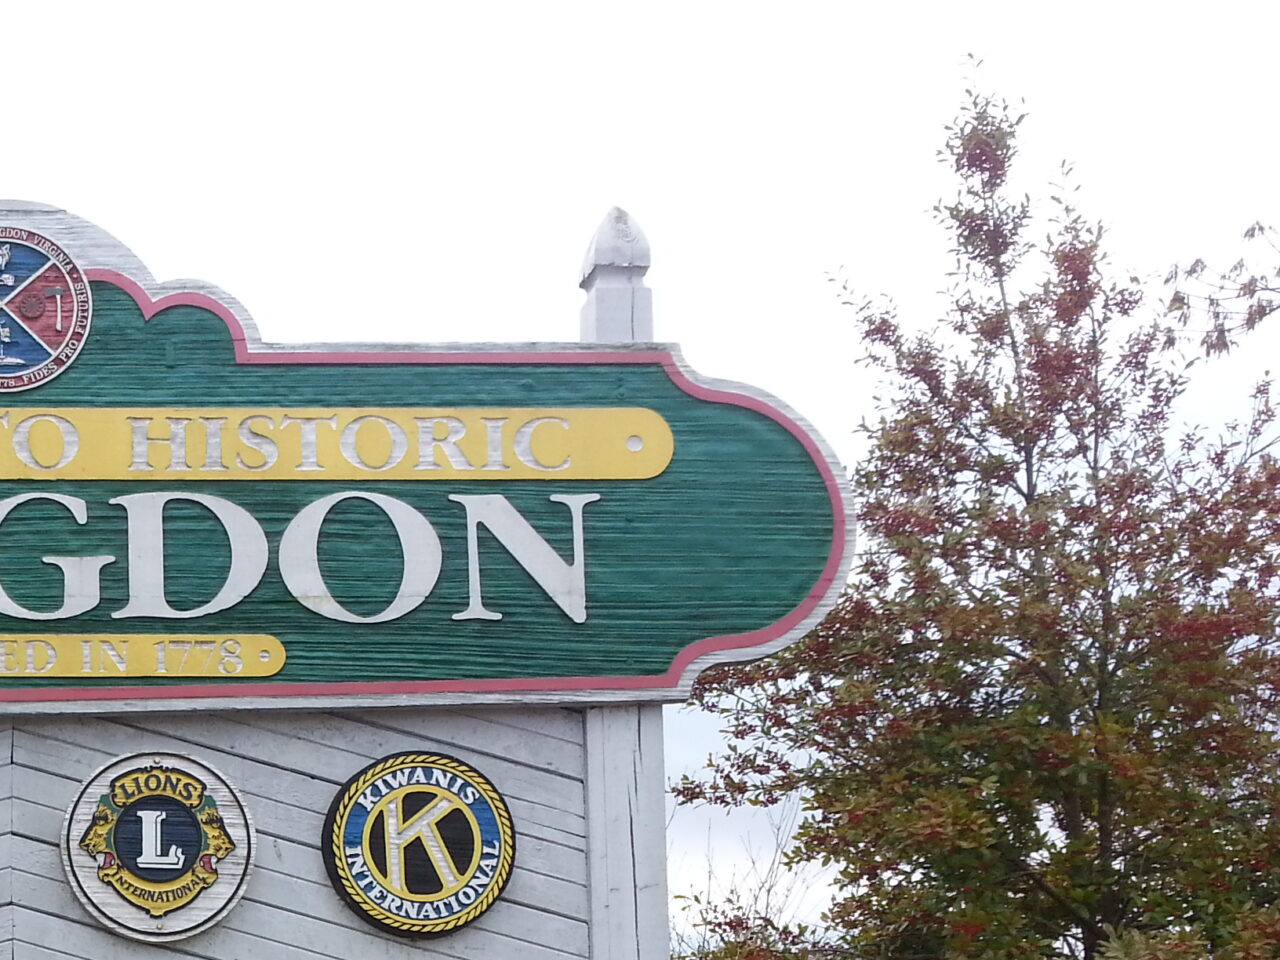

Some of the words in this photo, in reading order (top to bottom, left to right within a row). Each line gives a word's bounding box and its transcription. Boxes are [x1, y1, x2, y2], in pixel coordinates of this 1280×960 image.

[33, 235, 73, 272] VIRGINIA
[23, 363, 57, 384] FIDES
[59, 340, 77, 362] PRO
[75, 282, 88, 334] FUTURIS
[128, 413, 573, 471] HISTORIC
[81, 640, 127, 673] IN
[153, 640, 243, 674] 1778
[120, 774, 198, 800] LIONS
[357, 768, 480, 811] KIWANIS
[136, 810, 185, 869] L
[384, 796, 459, 890] K
[114, 871, 206, 902] INTERNATIONAL
[346, 841, 499, 919] INTERNATIONAL
